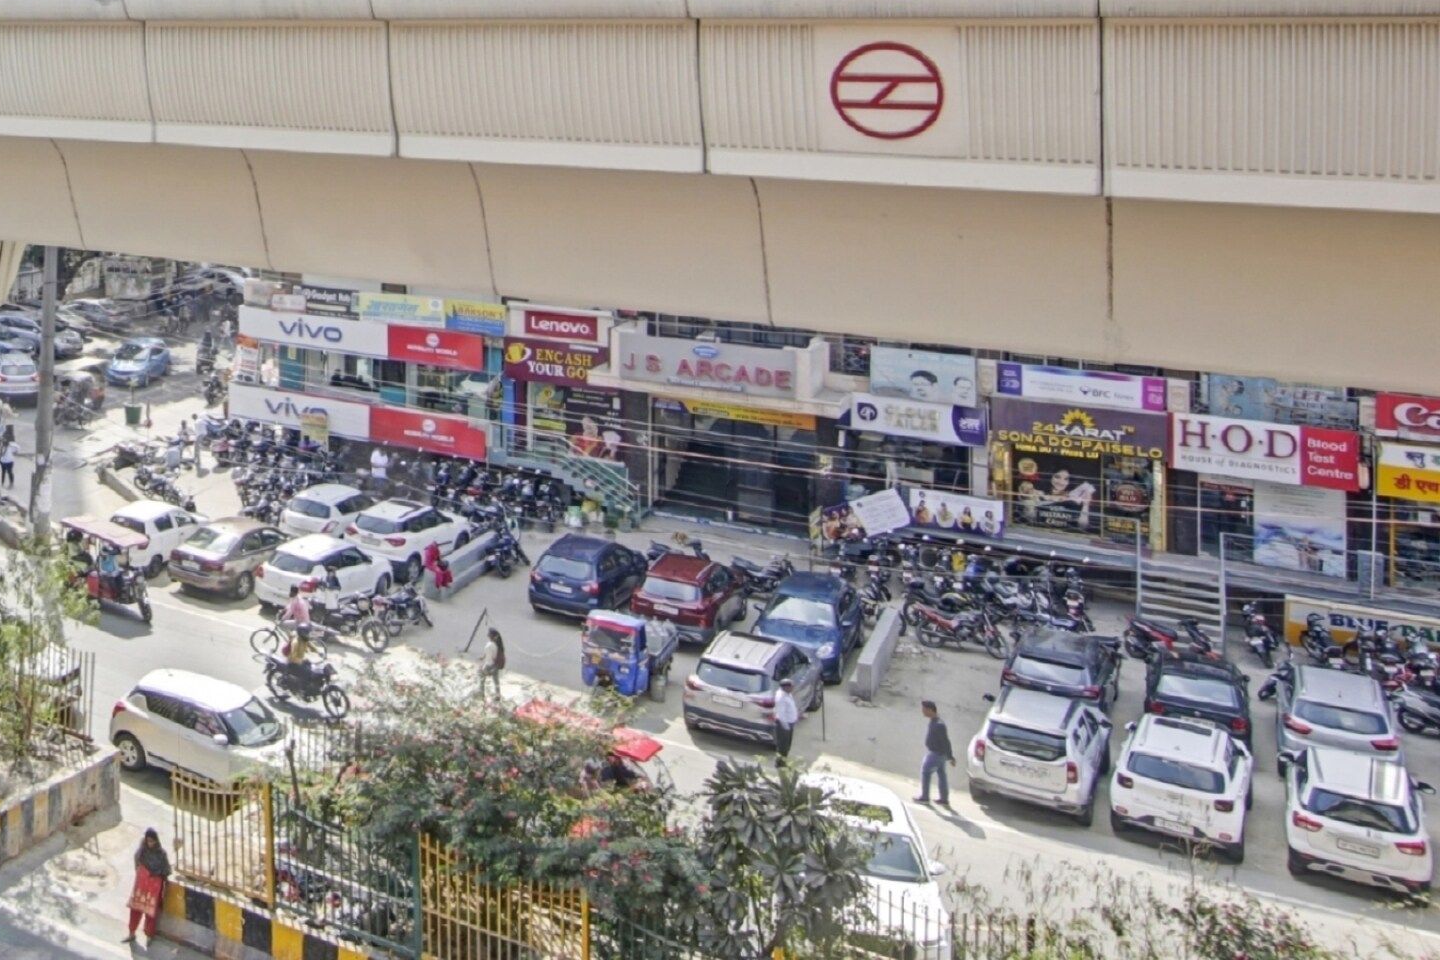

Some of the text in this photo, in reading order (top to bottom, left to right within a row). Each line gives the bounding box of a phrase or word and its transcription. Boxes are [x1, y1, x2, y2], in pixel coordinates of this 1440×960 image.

[278, 317, 342, 343] vivo
[531, 316, 590, 334] Lenovo
[536, 348, 592, 367] ENCASH
[527, 360, 564, 377] YOUR
[623, 353, 635, 371] J
[676, 358, 792, 390] ARCADE
[998, 430, 1045, 445] SONA
[1307, 437, 1347, 453] Blood
[1181, 454, 1297, 475] HOUSE of DIAGNOSTICS
[1307, 451, 1335, 464] Test
[1307, 465, 1354, 481] Centre
[1328, 613, 1388, 632] BLUE
